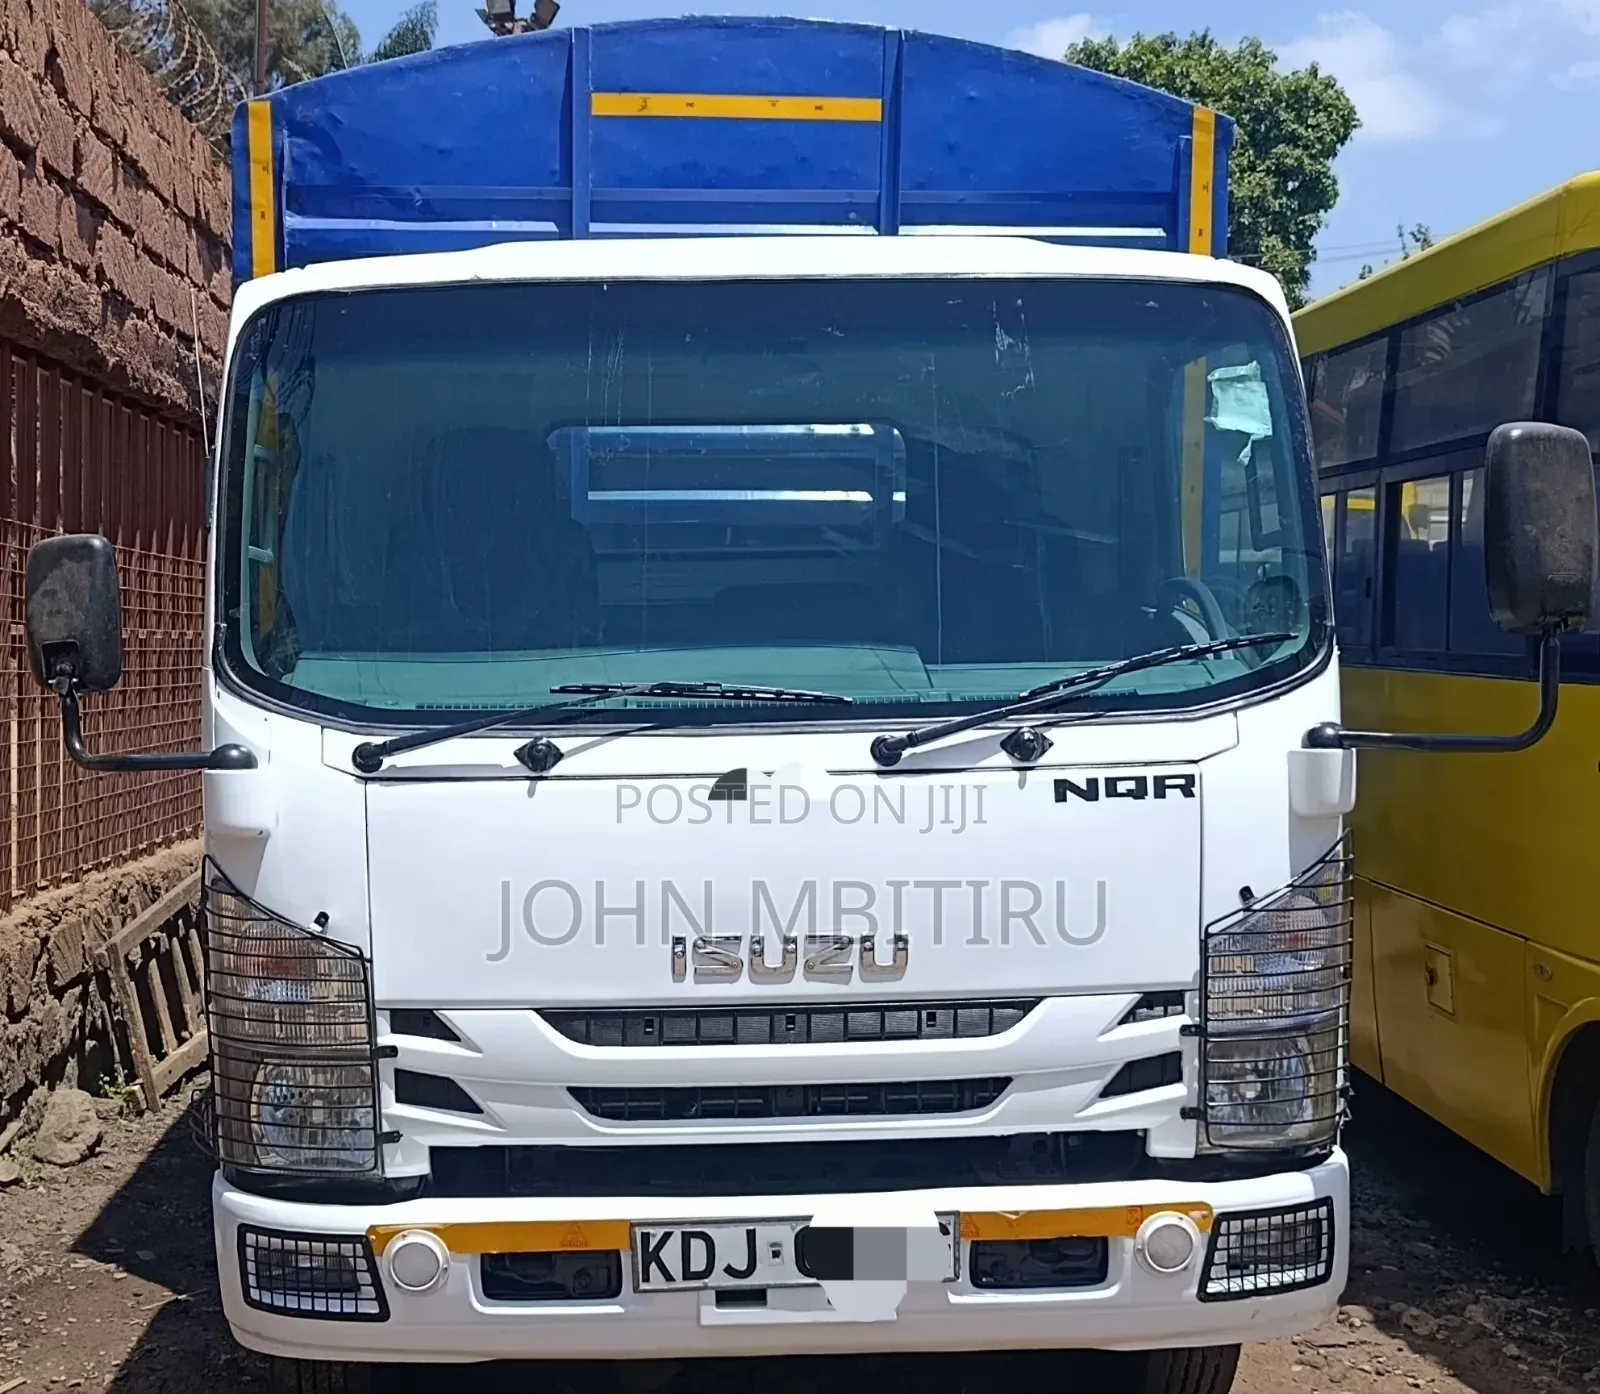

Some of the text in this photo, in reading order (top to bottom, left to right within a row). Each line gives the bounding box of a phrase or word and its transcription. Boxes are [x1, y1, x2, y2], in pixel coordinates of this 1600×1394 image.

[1053, 774, 1196, 803] NQR
[671, 932, 910, 985] ISUZU
[640, 1227, 758, 1283] KDJ
